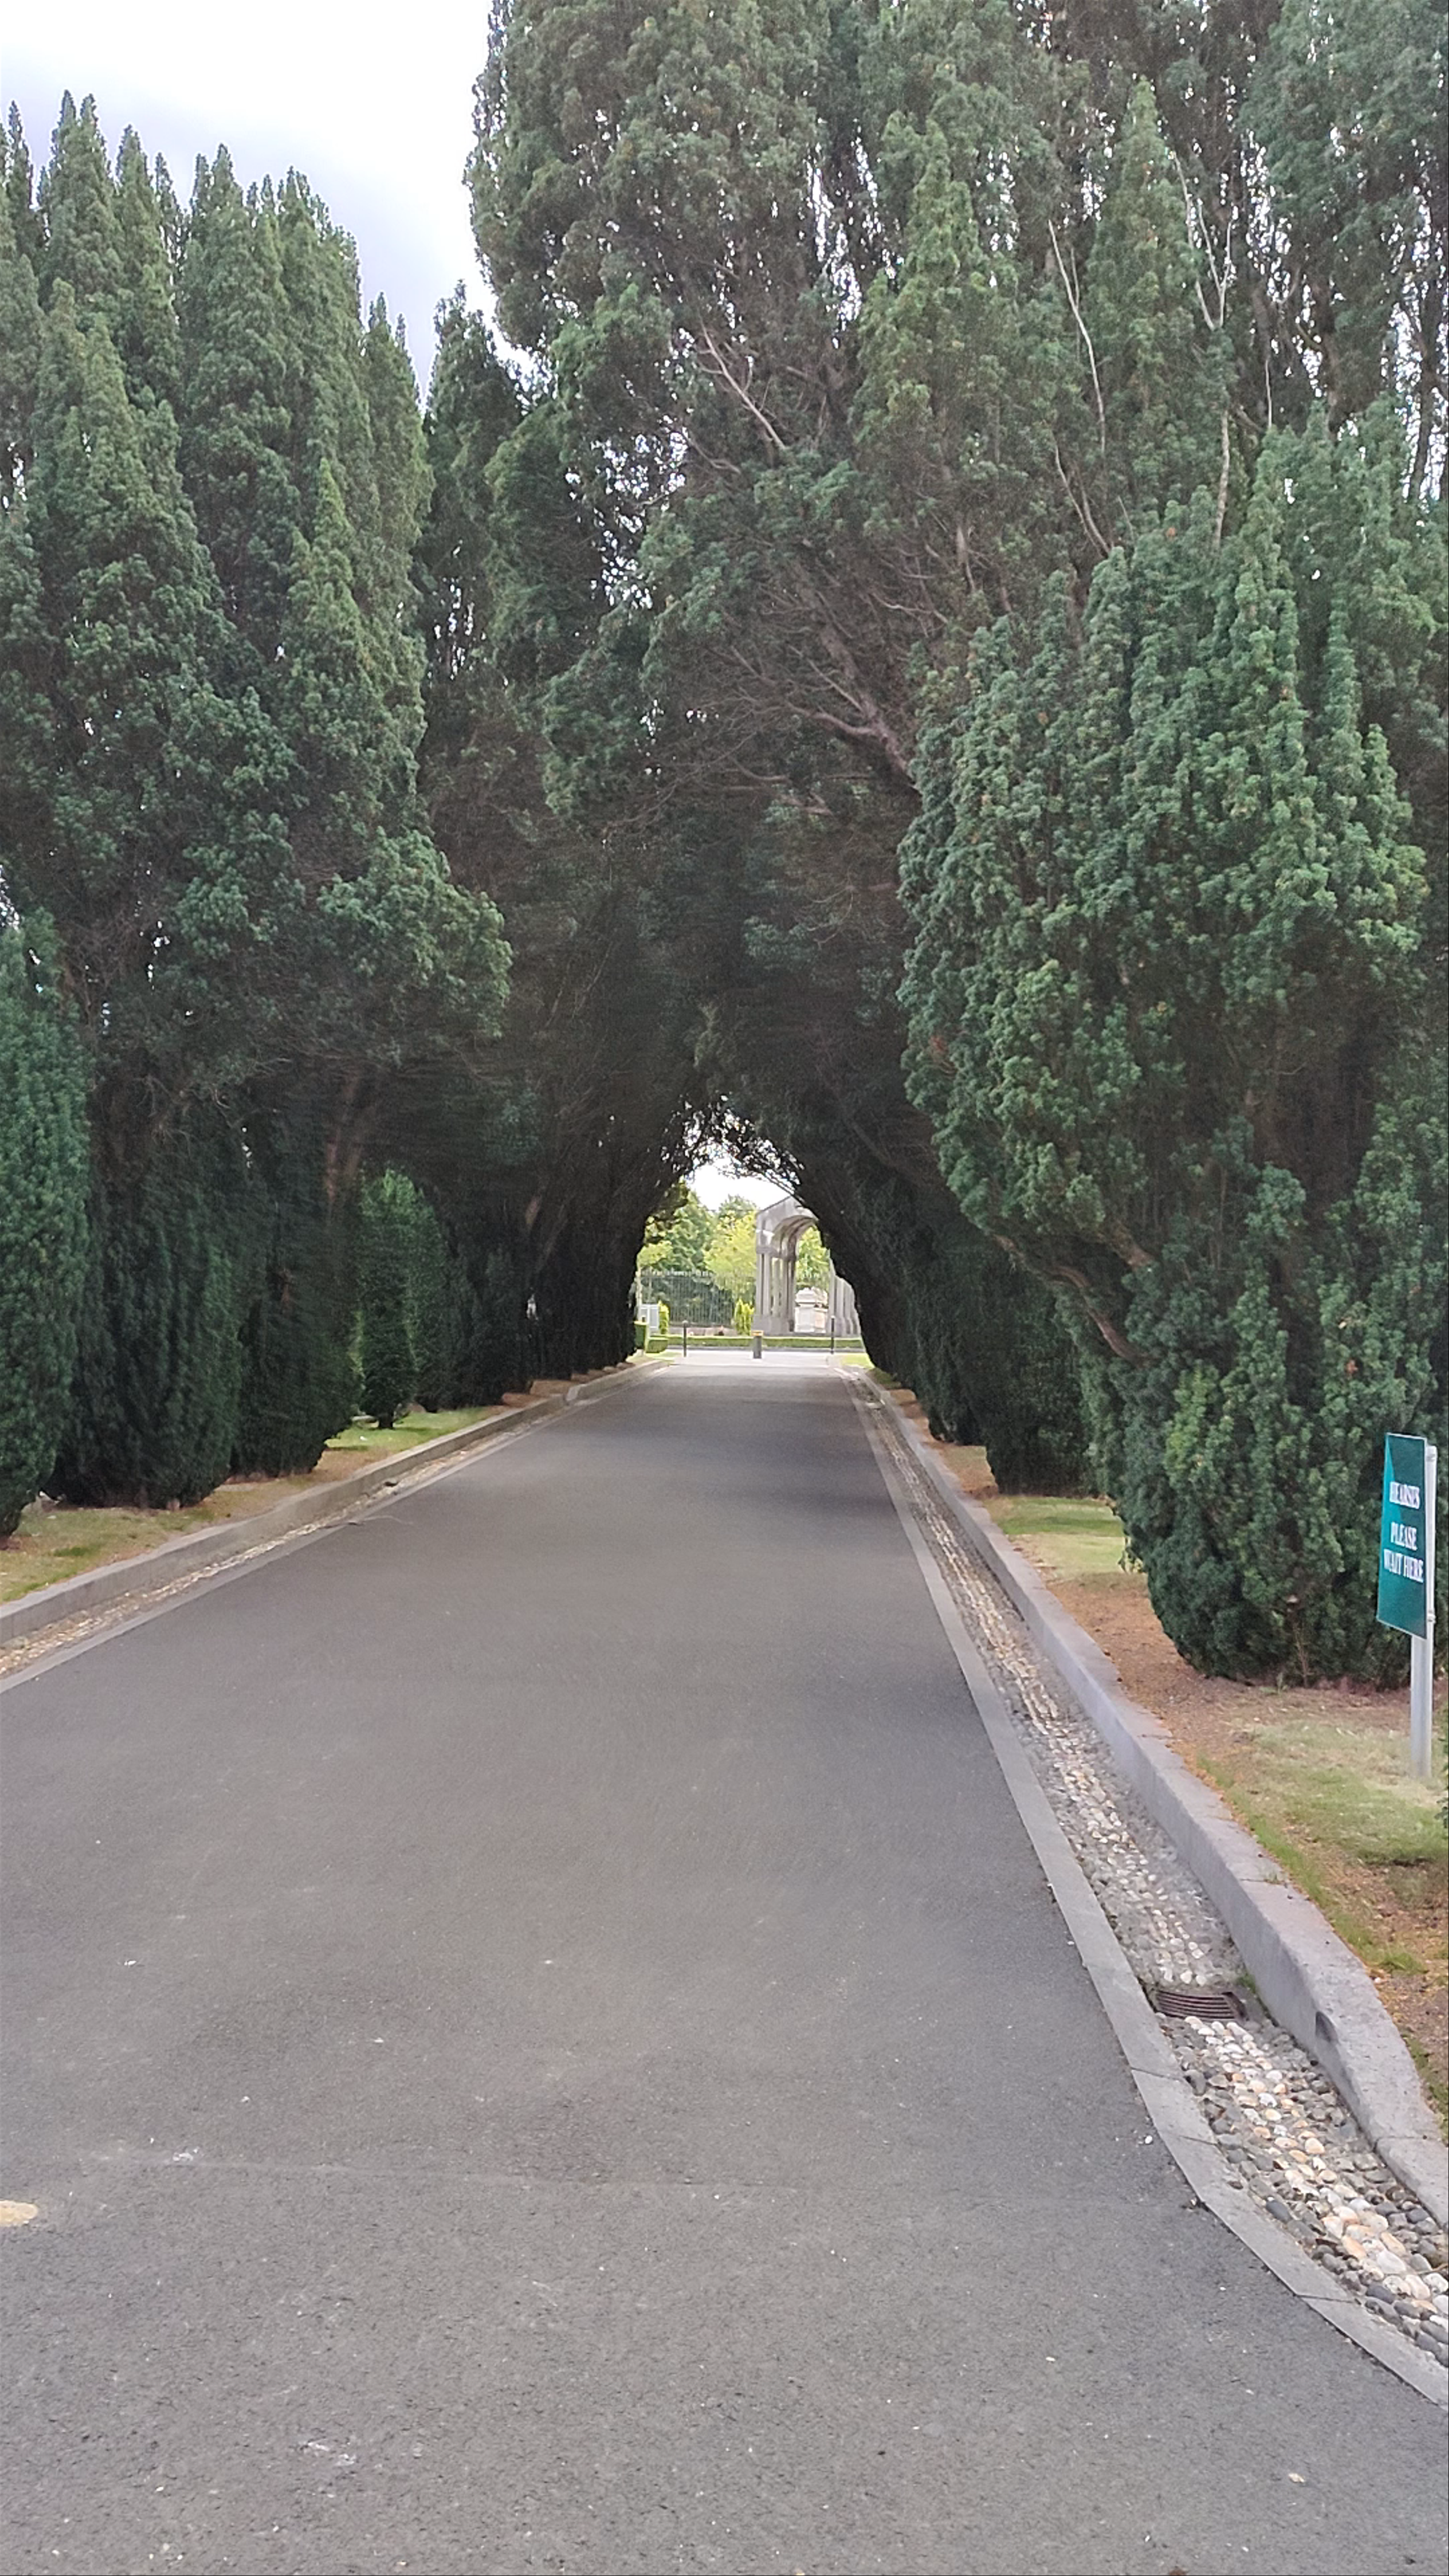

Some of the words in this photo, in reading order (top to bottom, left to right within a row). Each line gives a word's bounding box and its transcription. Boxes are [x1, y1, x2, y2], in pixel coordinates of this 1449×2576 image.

[1391, 1522, 1417, 1551] PLEASE
[1384, 1549, 1403, 1575] WAIT
[1403, 1555, 1424, 1583] HERE
